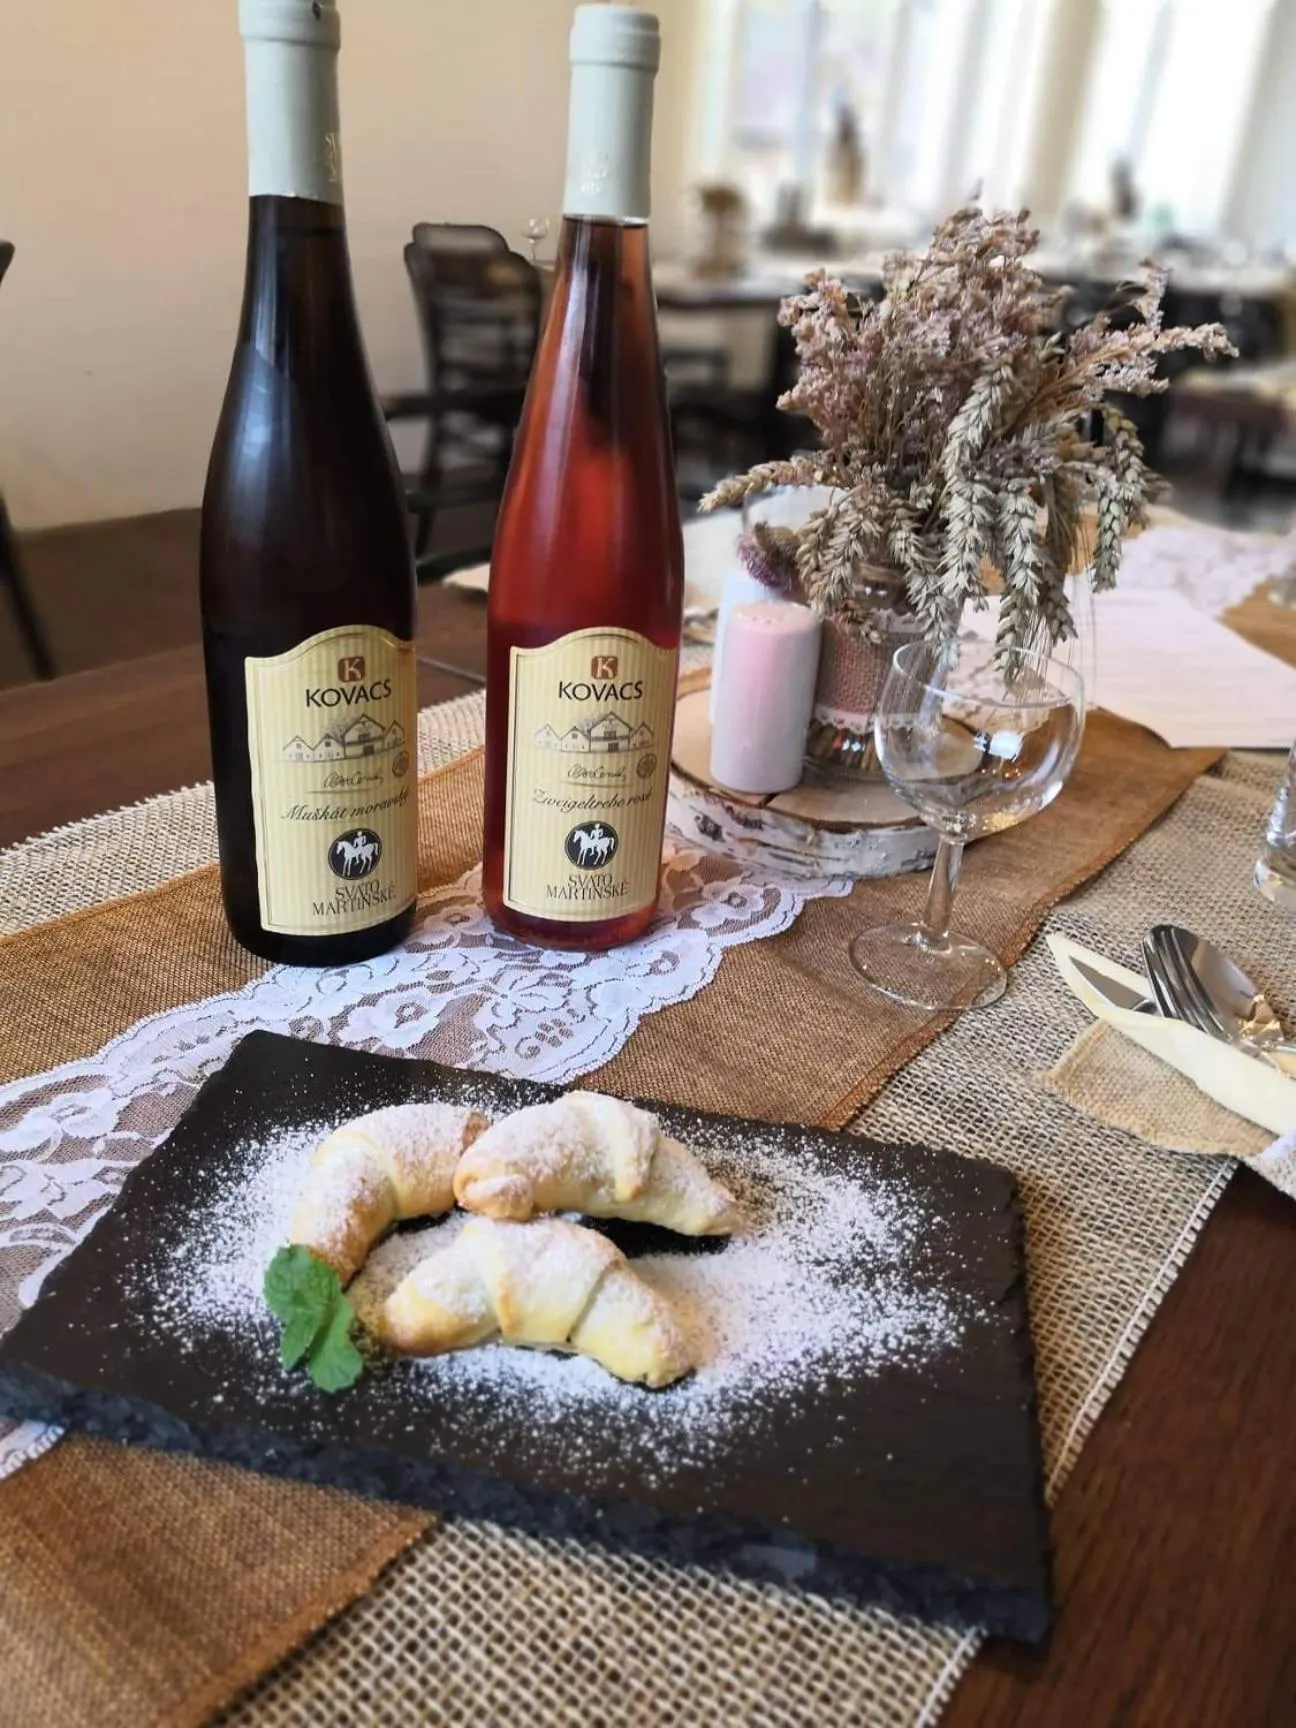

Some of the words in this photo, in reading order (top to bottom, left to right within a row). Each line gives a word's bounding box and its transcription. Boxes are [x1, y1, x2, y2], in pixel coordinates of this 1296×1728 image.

[344, 657, 363, 681] K
[597, 657, 614, 678] K
[305, 678, 392, 708] KOVACS
[558, 680, 644, 702] KOVACS
[335, 879, 380, 899] SVATO
[567, 873, 613, 889] SVATO
